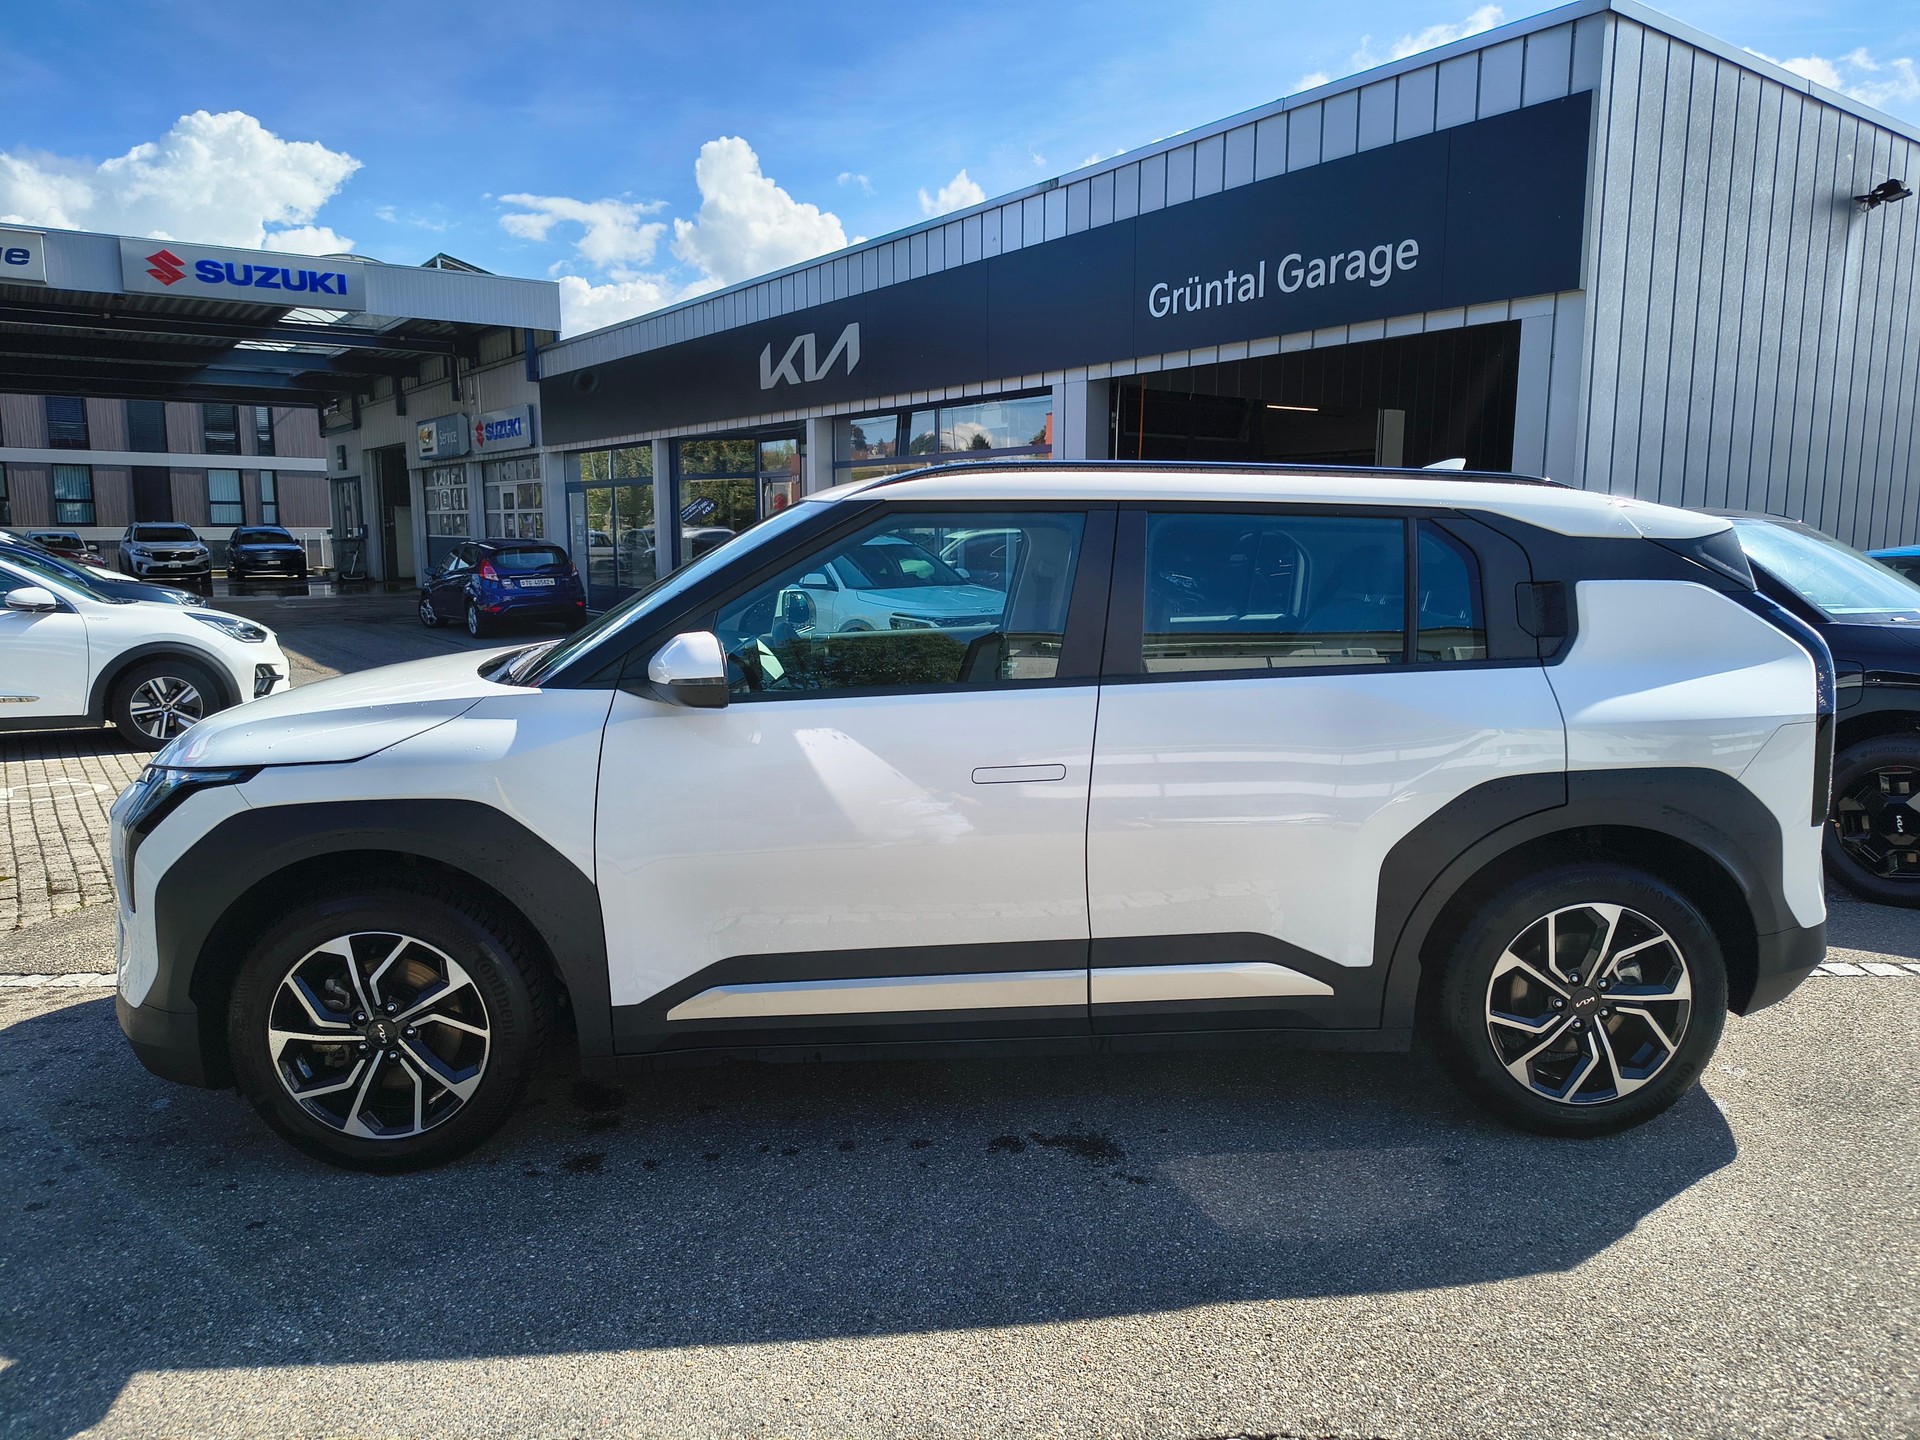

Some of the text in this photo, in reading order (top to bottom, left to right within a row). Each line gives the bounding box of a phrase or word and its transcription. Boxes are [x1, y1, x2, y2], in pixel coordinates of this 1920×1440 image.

[0, 246, 31, 266] e
[195, 258, 348, 296] SUZUKI
[1148, 238, 1420, 319] Grüntal Garage
[760, 322, 860, 390] KIA
[439, 428, 458, 445] Service
[485, 417, 522, 441] SUZUKI
